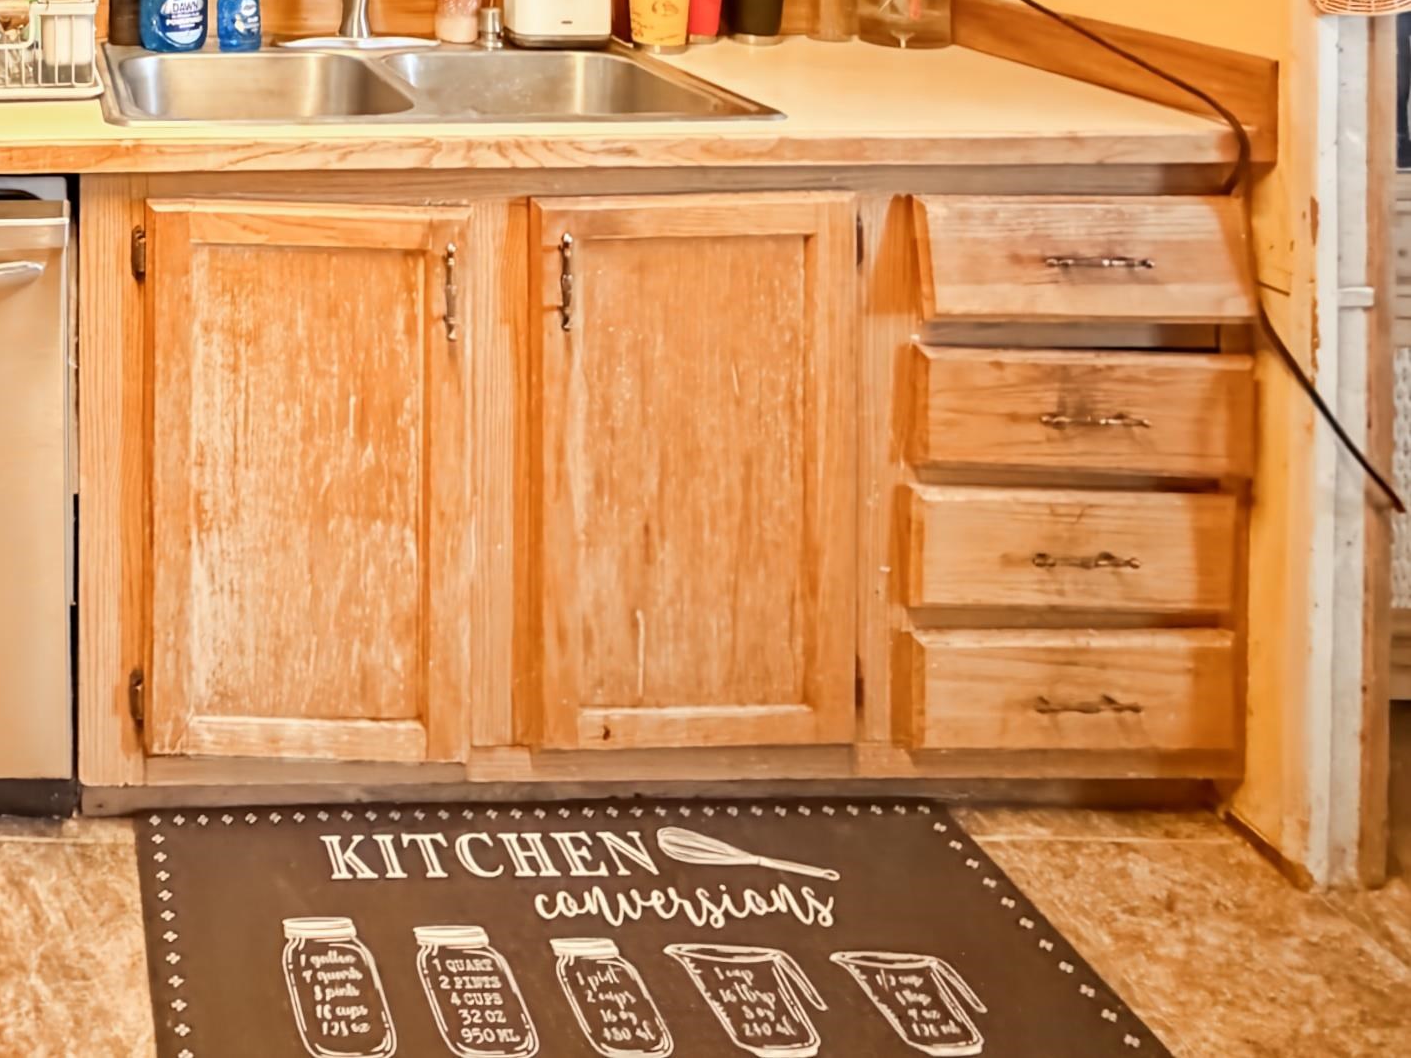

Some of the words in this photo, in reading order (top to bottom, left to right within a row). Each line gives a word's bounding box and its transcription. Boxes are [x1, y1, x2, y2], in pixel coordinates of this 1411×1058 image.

[172, 1, 198, 13] DAWN
[320, 830, 661, 881] KITCHEN
[534, 884, 835, 929] conversions
[310, 950, 356, 968] gallon
[432, 958, 441, 972] 1
[445, 959, 494, 973] QUART
[439, 975, 451, 989] 2
[453, 976, 502, 989] PINTS
[576, 971, 585, 986] 1
[713, 966, 725, 981] 1
[725, 968, 754, 986] cup
[451, 992, 461, 1006] 4
[463, 992, 504, 1005] CUPS
[585, 989, 596, 1003] 2
[719, 988, 737, 1003] 16
[335, 1005, 368, 1020] cups
[458, 1009, 483, 1025] 32
[485, 1010, 507, 1023] OZ
[599, 1008, 618, 1023] 16
[461, 1027, 496, 1044] 950
[496, 1028, 521, 1043] ML
